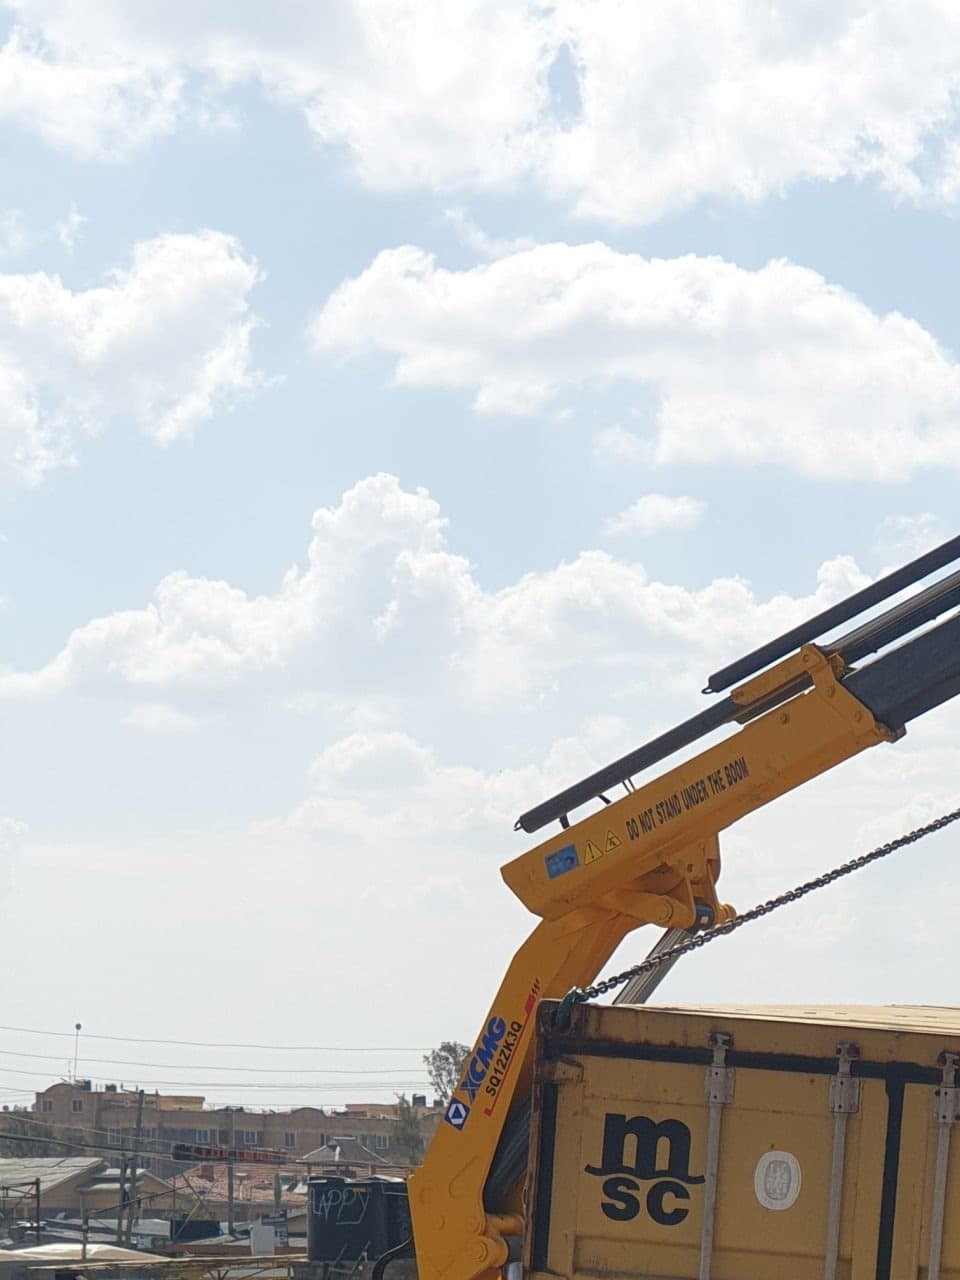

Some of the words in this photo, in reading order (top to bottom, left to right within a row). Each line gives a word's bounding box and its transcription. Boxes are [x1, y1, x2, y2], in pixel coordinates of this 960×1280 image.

[626, 820, 640, 840] DO
[638, 807, 656, 833] NOT
[655, 793, 682, 825] STAND
[681, 778, 710, 810] UNDER
[708, 769, 726, 796] THE
[724, 756, 750, 786] BOOM
[459, 1016, 506, 1104] XCMG
[485, 1020, 522, 1097] SQ12ZK3Q
